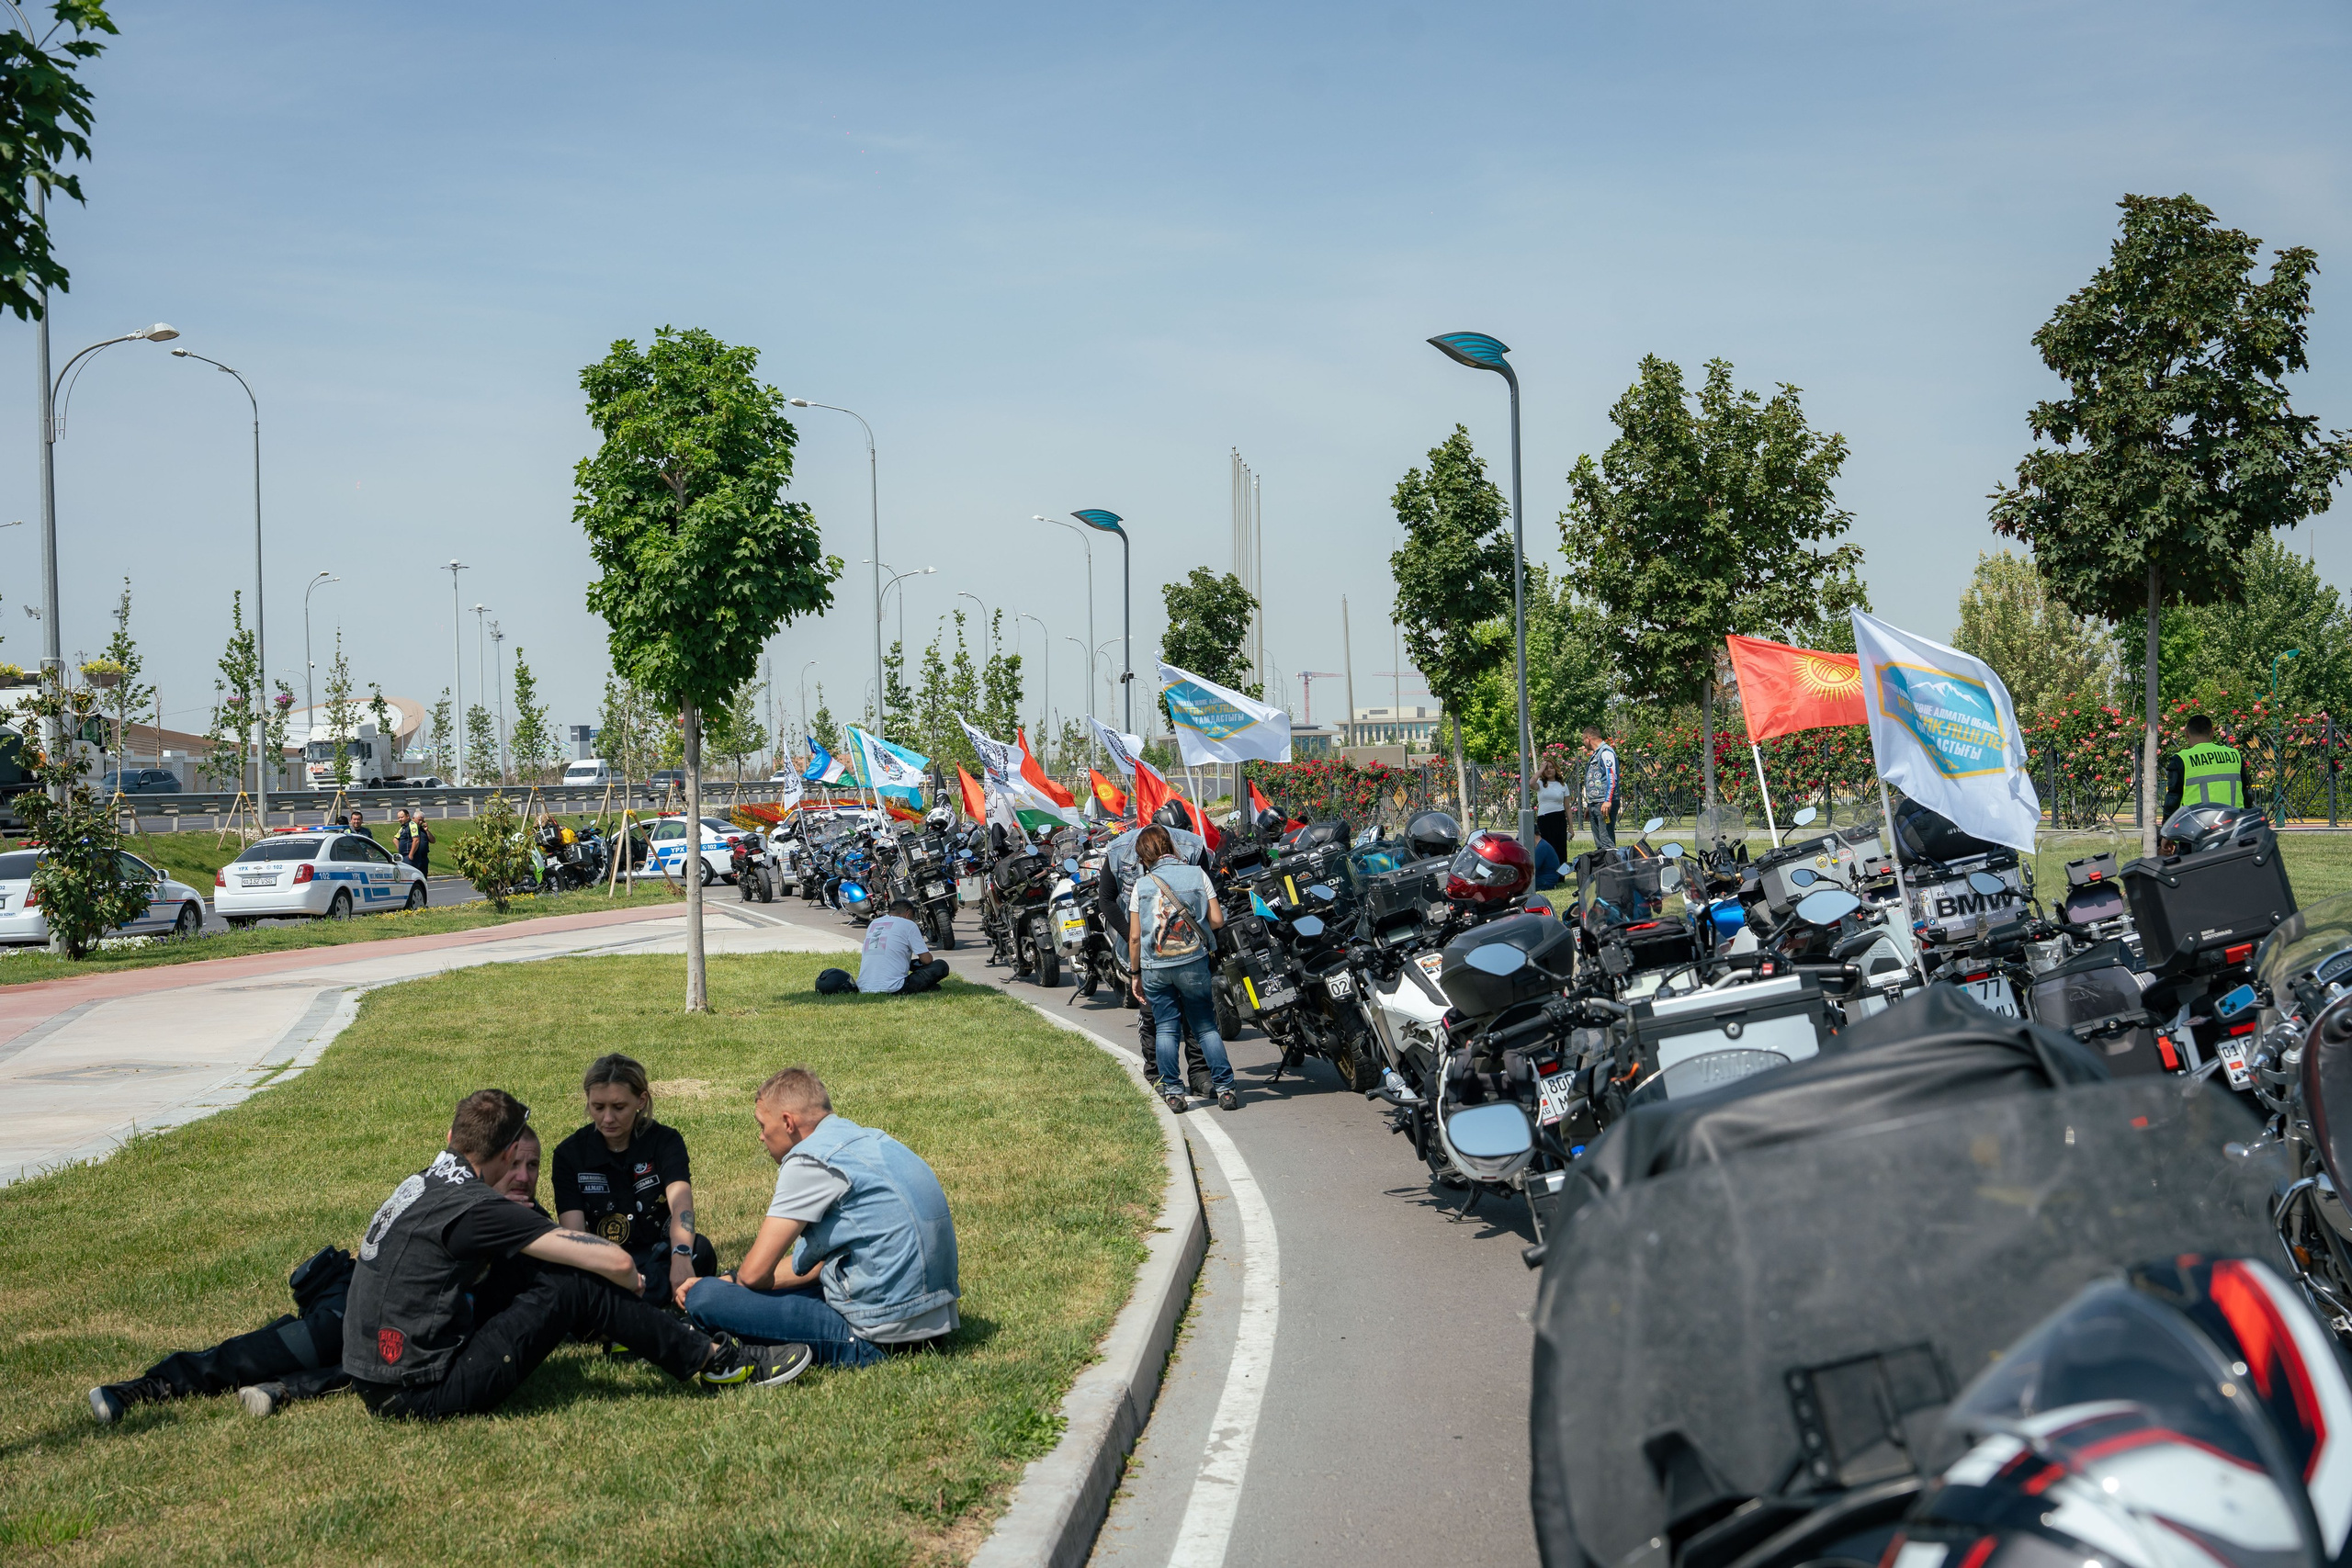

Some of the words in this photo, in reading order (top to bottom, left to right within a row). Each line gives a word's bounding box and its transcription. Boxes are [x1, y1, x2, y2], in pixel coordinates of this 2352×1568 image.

[2188, 751, 2240, 768] МАРШАЛ
[319, 872, 331, 880] 102
[1936, 892, 2014, 918] BMW
[1330, 980, 1351, 996] 02
[1976, 978, 2000, 1000] 77
[2222, 1044, 2240, 1058] 01
